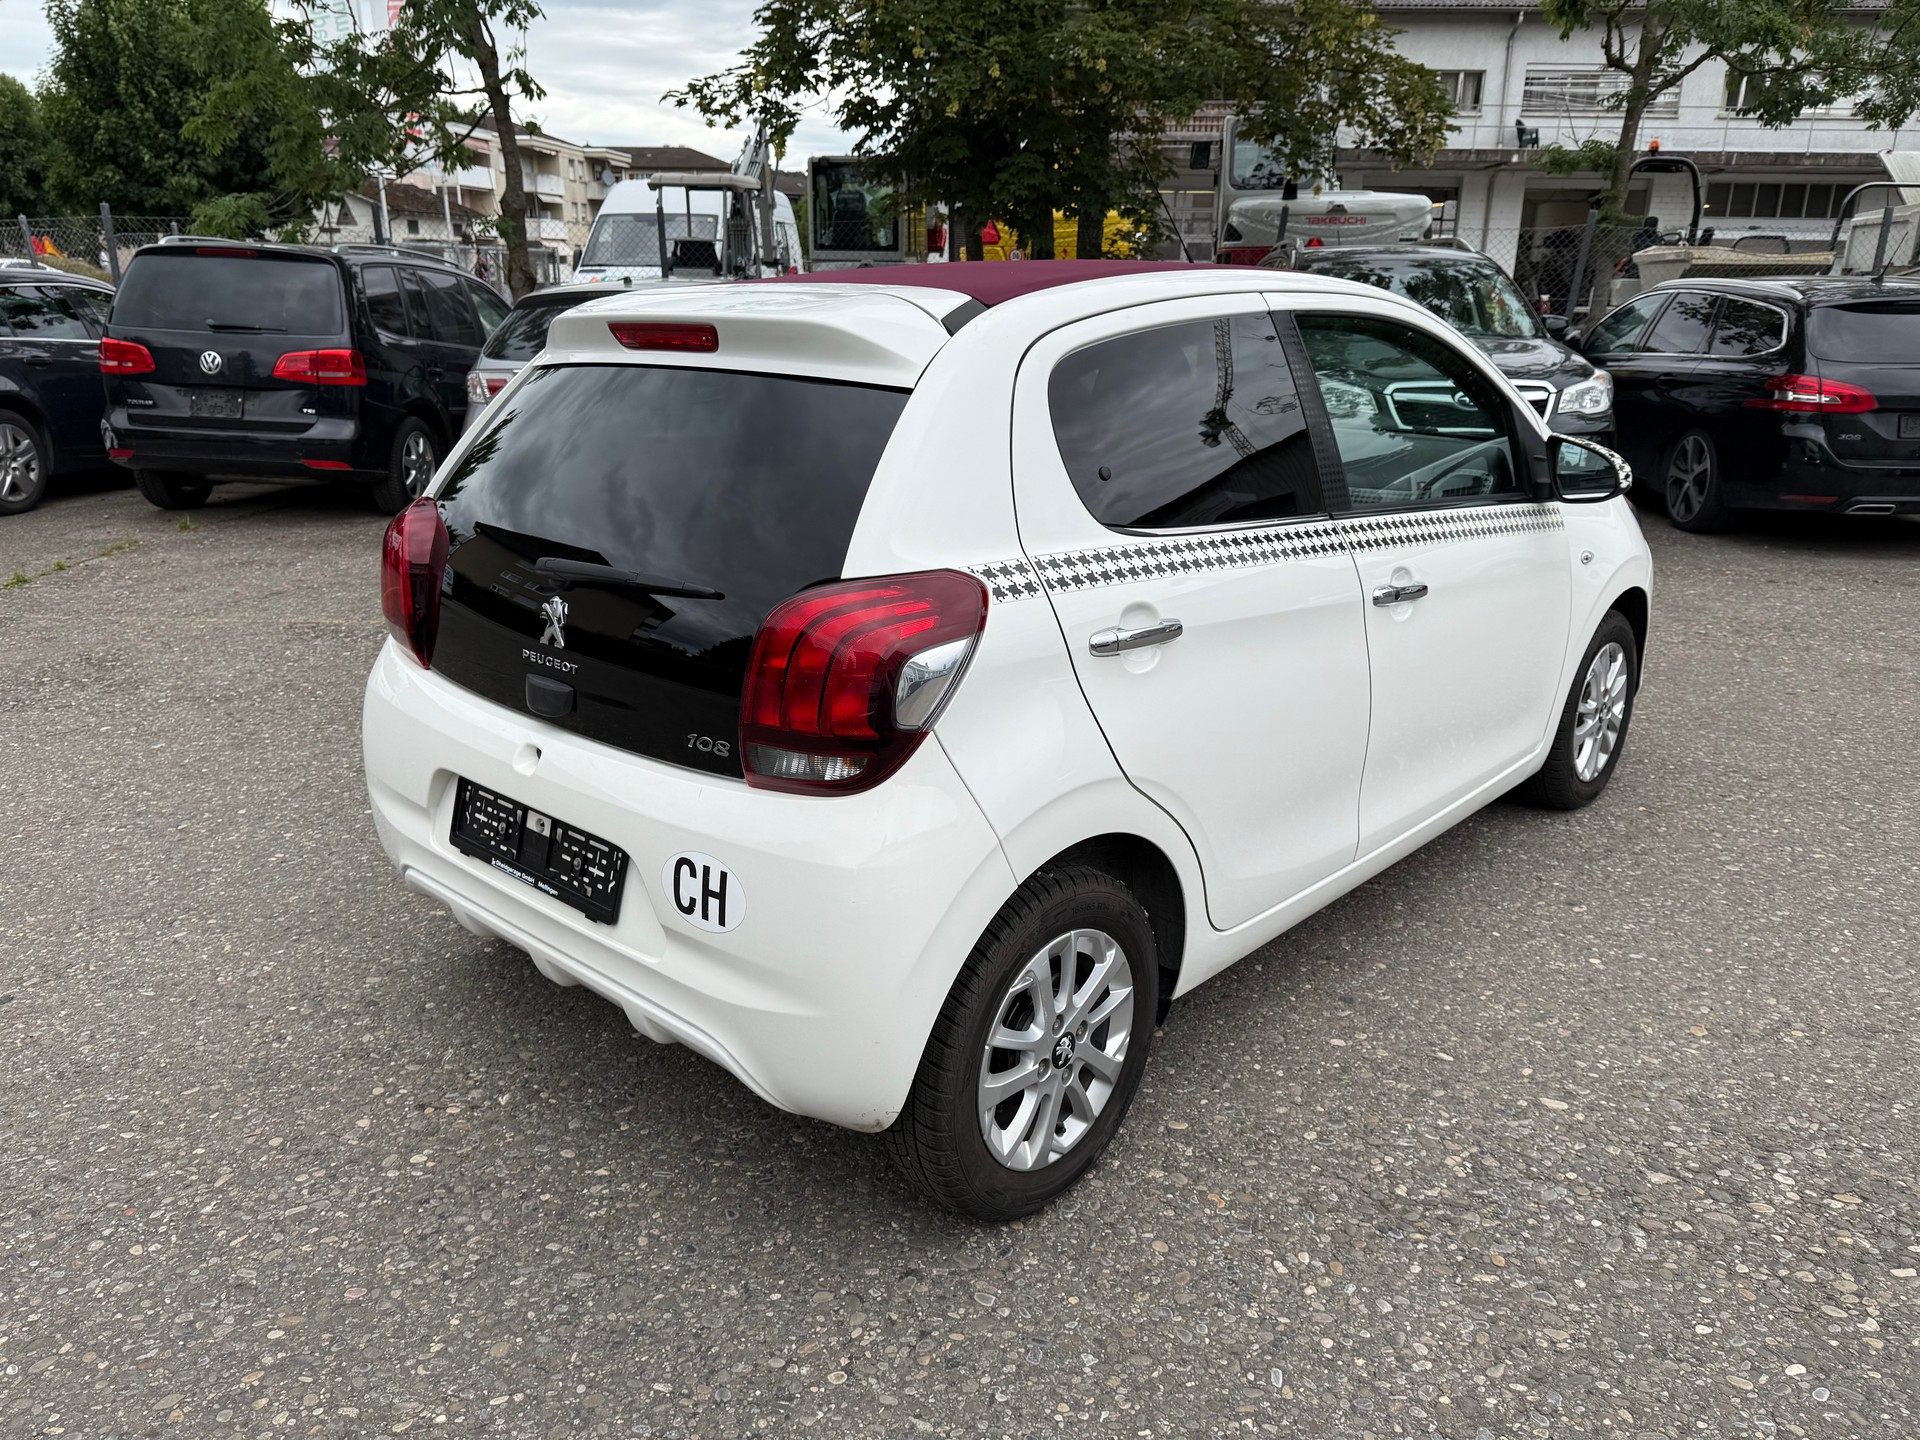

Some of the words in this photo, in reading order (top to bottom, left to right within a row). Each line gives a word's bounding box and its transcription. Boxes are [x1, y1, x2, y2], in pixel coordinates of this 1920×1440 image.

[522, 648, 579, 675] PEUGEOT
[687, 733, 731, 757] 108
[521, 872, 535, 884] GmbH
[673, 856, 728, 928] CH
